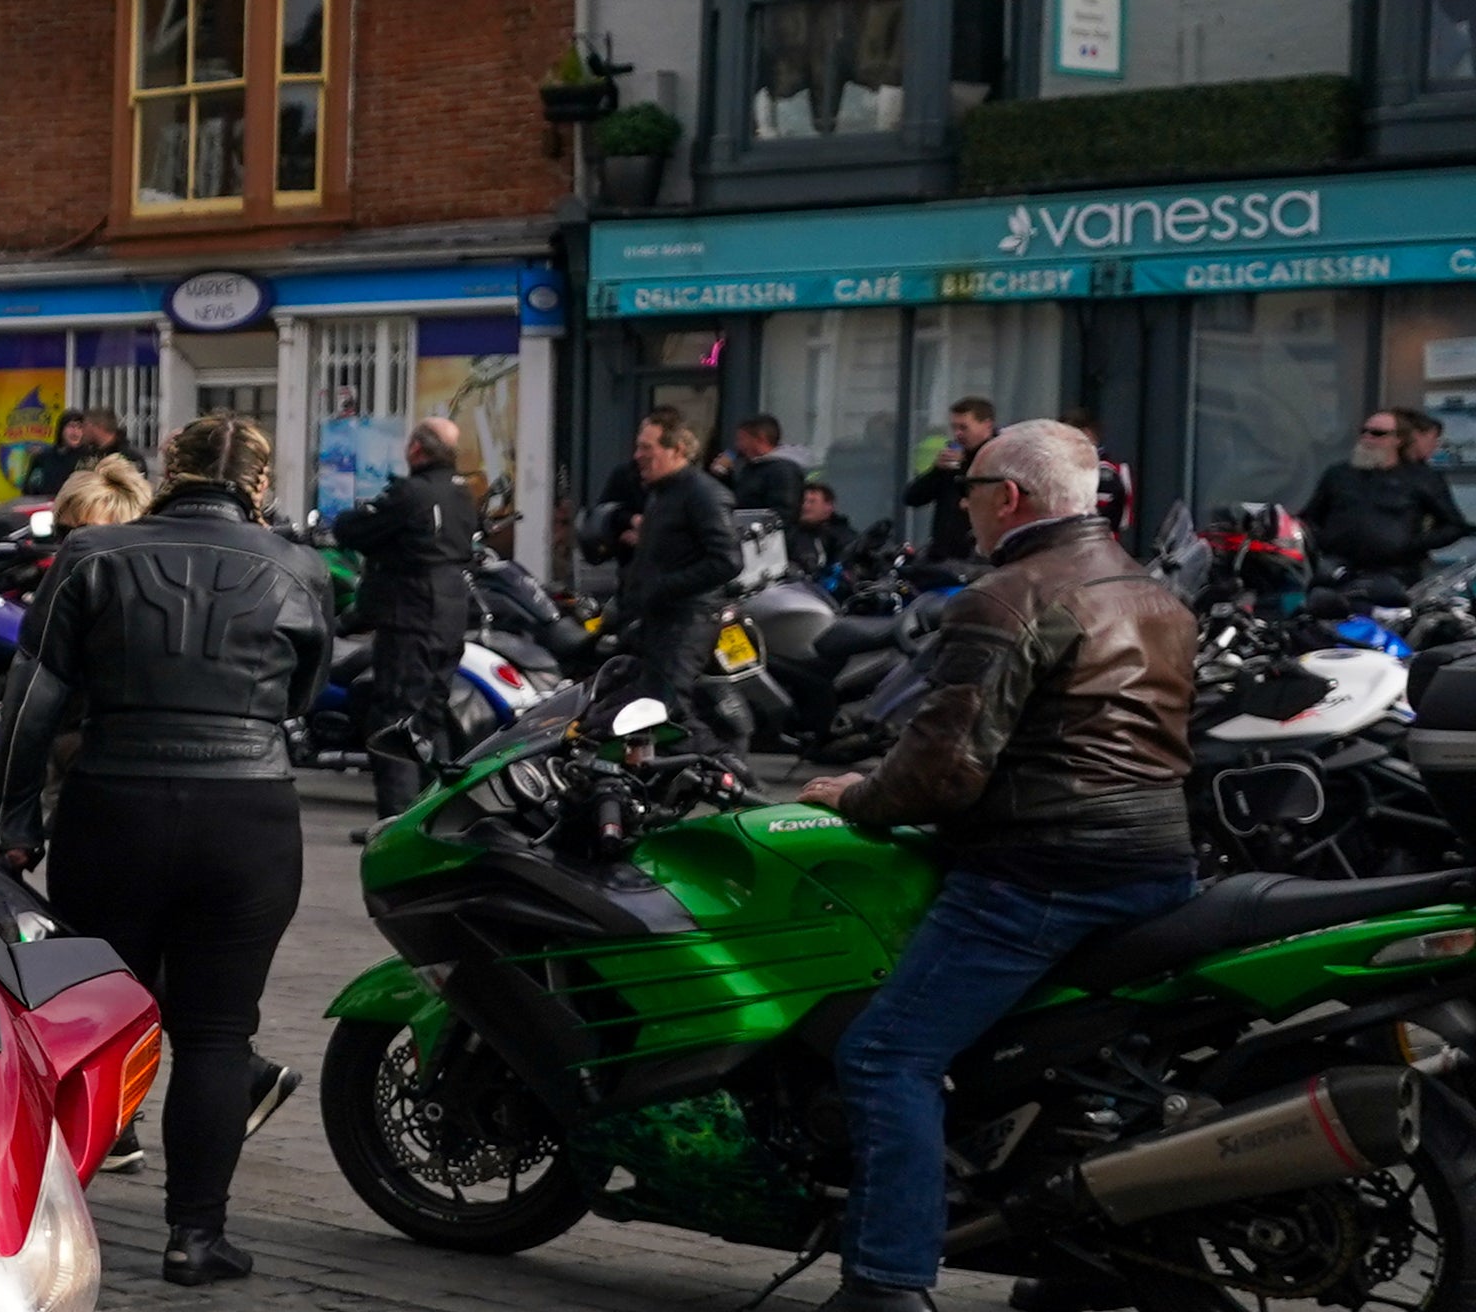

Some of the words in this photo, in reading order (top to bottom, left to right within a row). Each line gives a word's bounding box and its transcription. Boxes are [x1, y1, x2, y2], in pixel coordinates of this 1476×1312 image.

[1039, 190, 1321, 248] vanessa
[1185, 255, 1391, 288] DELICATESSEN
[183, 278, 242, 297] MARKET
[634, 282, 797, 310] DELICATESSEN
[833, 273, 902, 302] CAFÉ
[941, 270, 1072, 296] BUTCHERY
[194, 303, 235, 321] NEWS
[768, 817, 845, 834] Kawas
